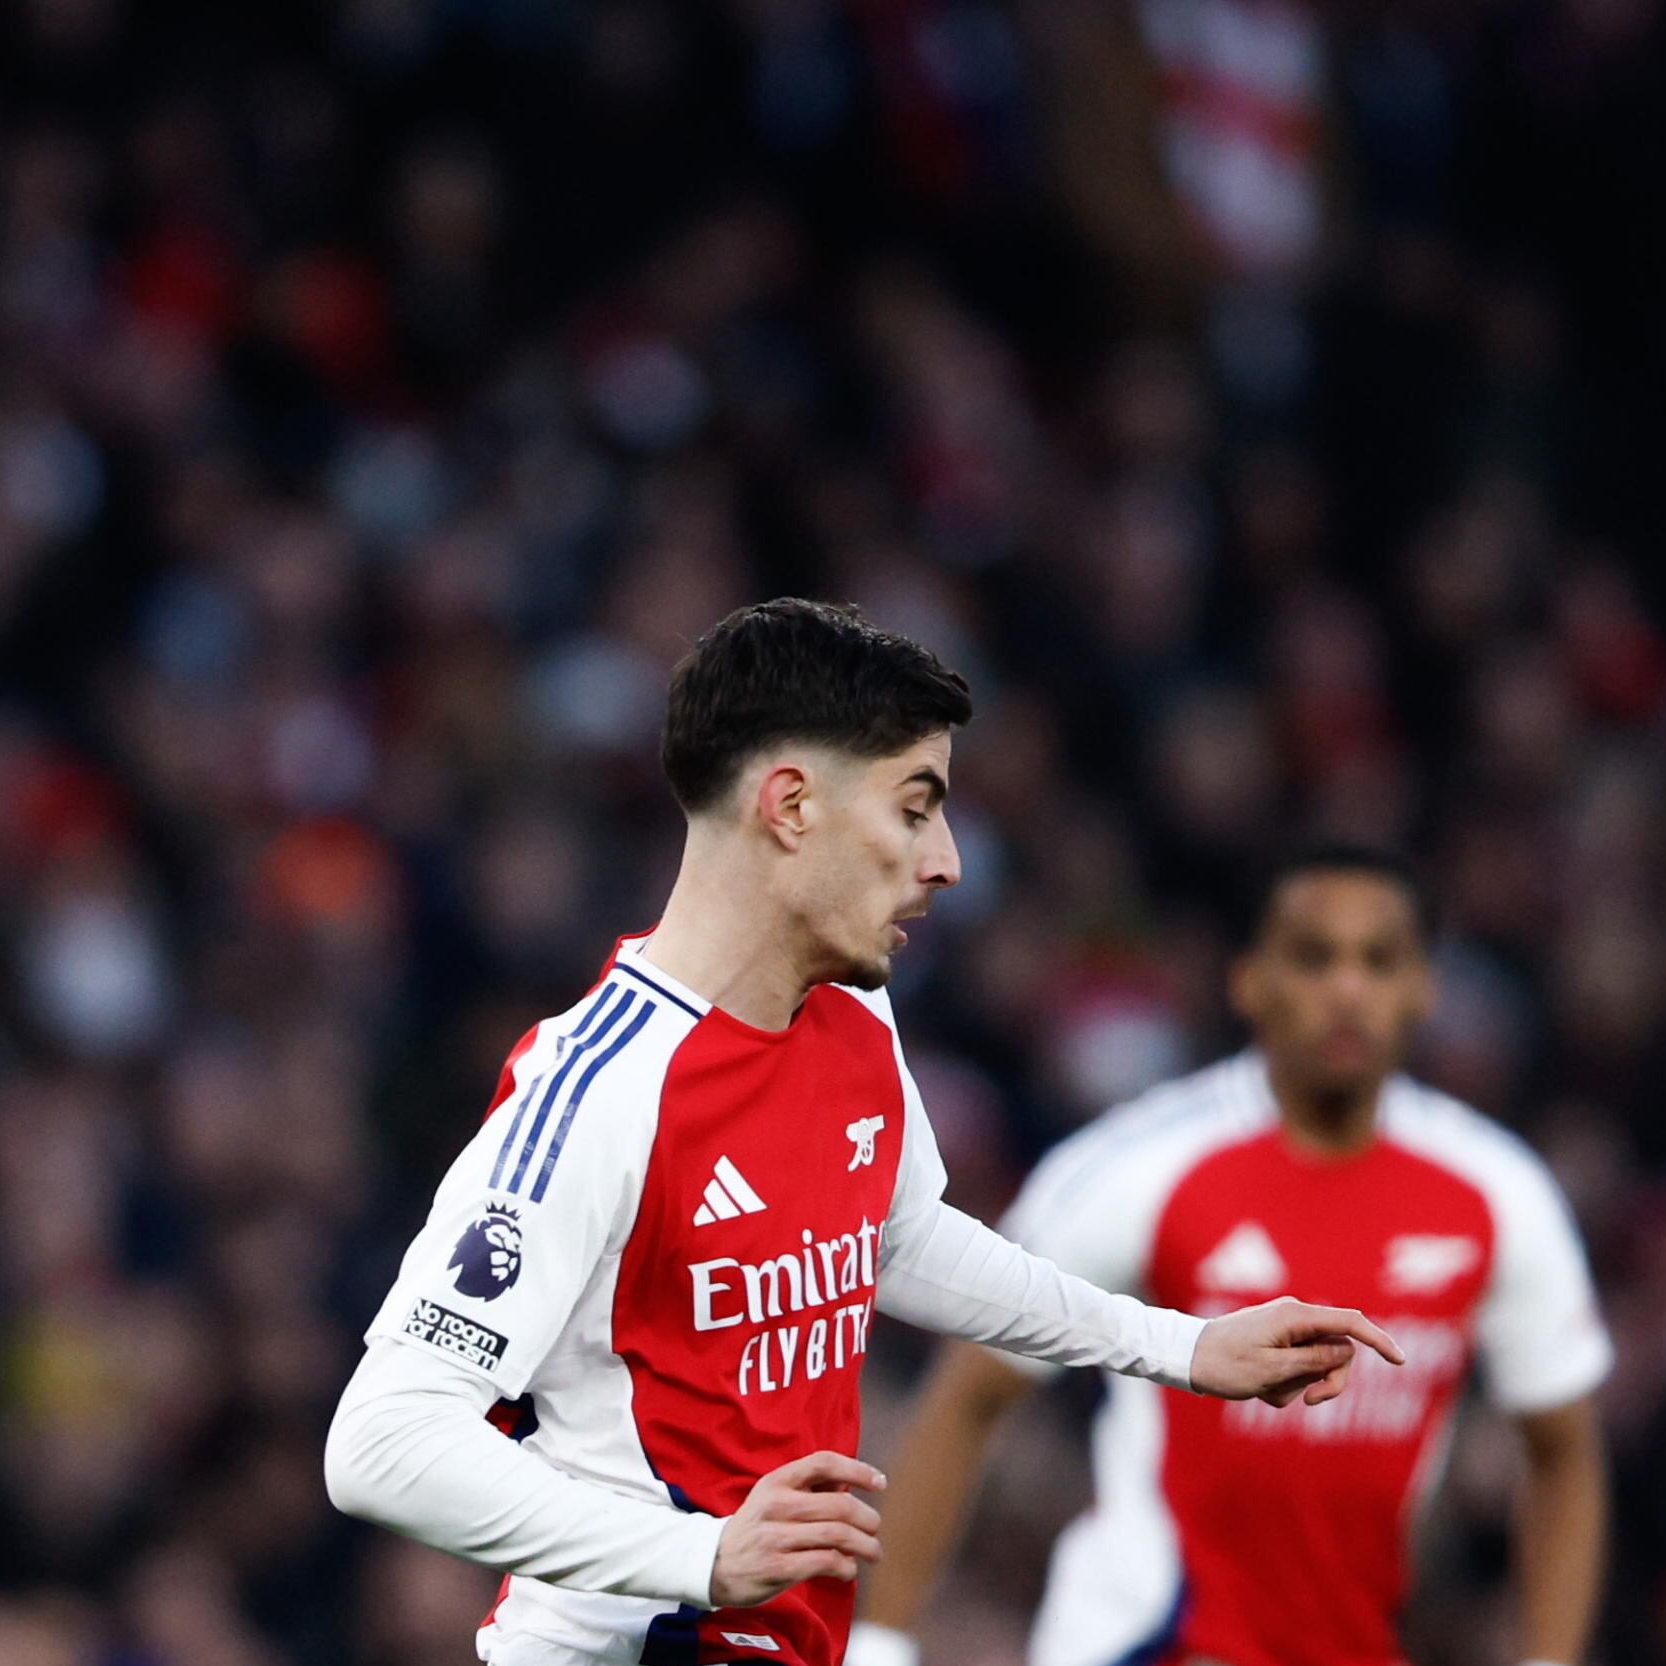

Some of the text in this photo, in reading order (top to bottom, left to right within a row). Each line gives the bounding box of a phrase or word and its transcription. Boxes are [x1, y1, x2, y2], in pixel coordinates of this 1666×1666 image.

[687, 1215, 888, 1332] Emirat
[403, 1314, 499, 1373] for racism
[412, 1299, 499, 1352] No room
[738, 1325, 800, 1396] FLY
